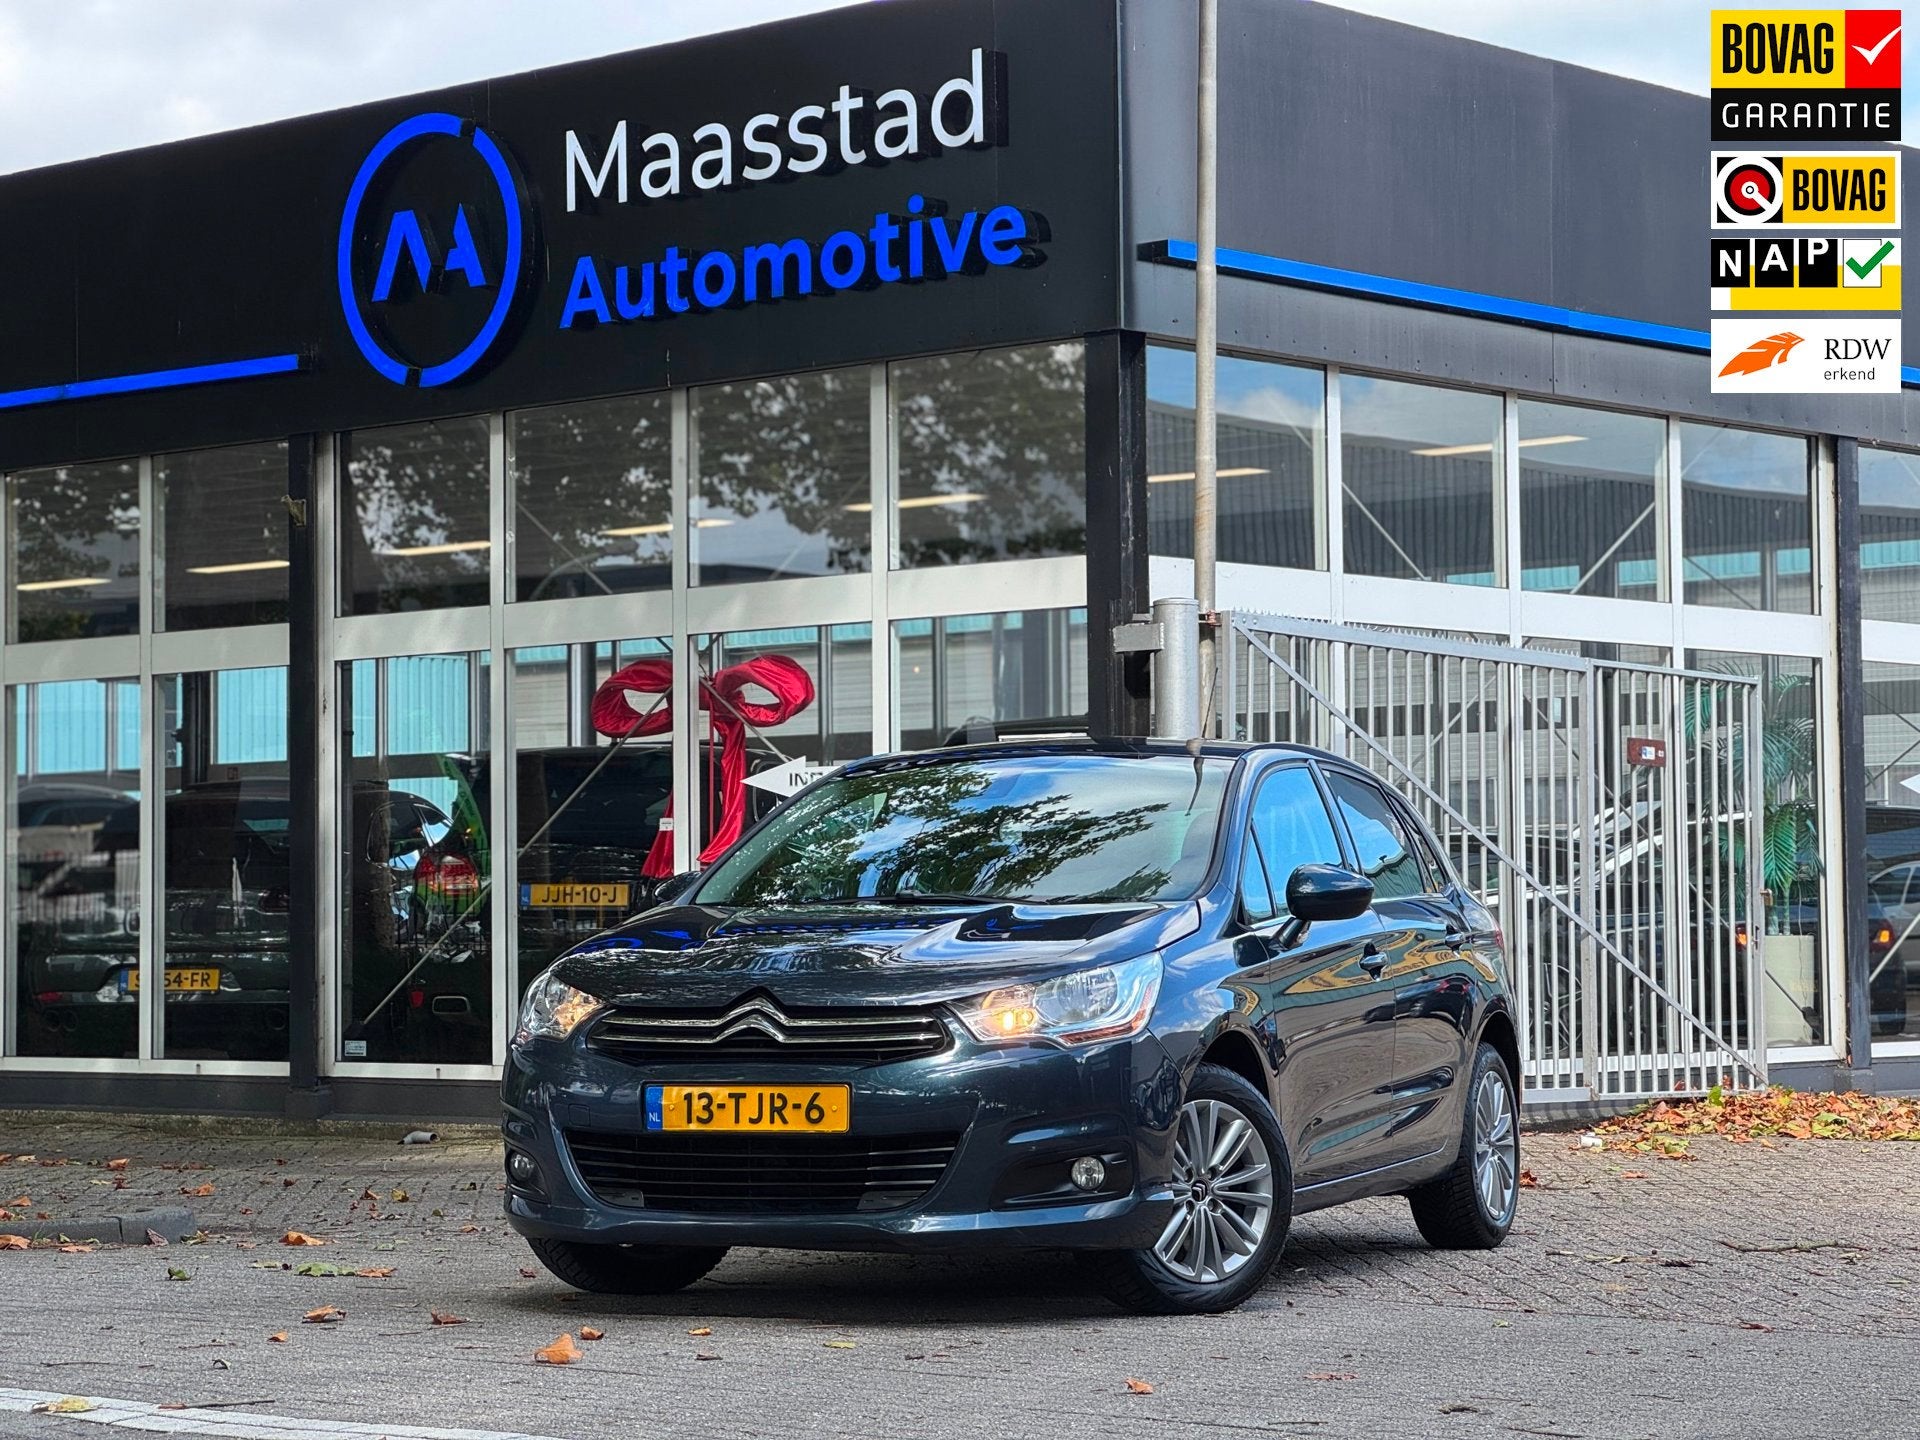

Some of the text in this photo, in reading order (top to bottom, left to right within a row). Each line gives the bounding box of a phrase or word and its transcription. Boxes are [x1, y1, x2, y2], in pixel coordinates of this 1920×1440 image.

[565, 47, 987, 213] Maasstad
[559, 194, 1028, 330] Automotive
[541, 886, 617, 903] JJH-10-J
[649, 1112, 661, 1123] NL
[683, 1092, 825, 1125] 13-TJR-6
